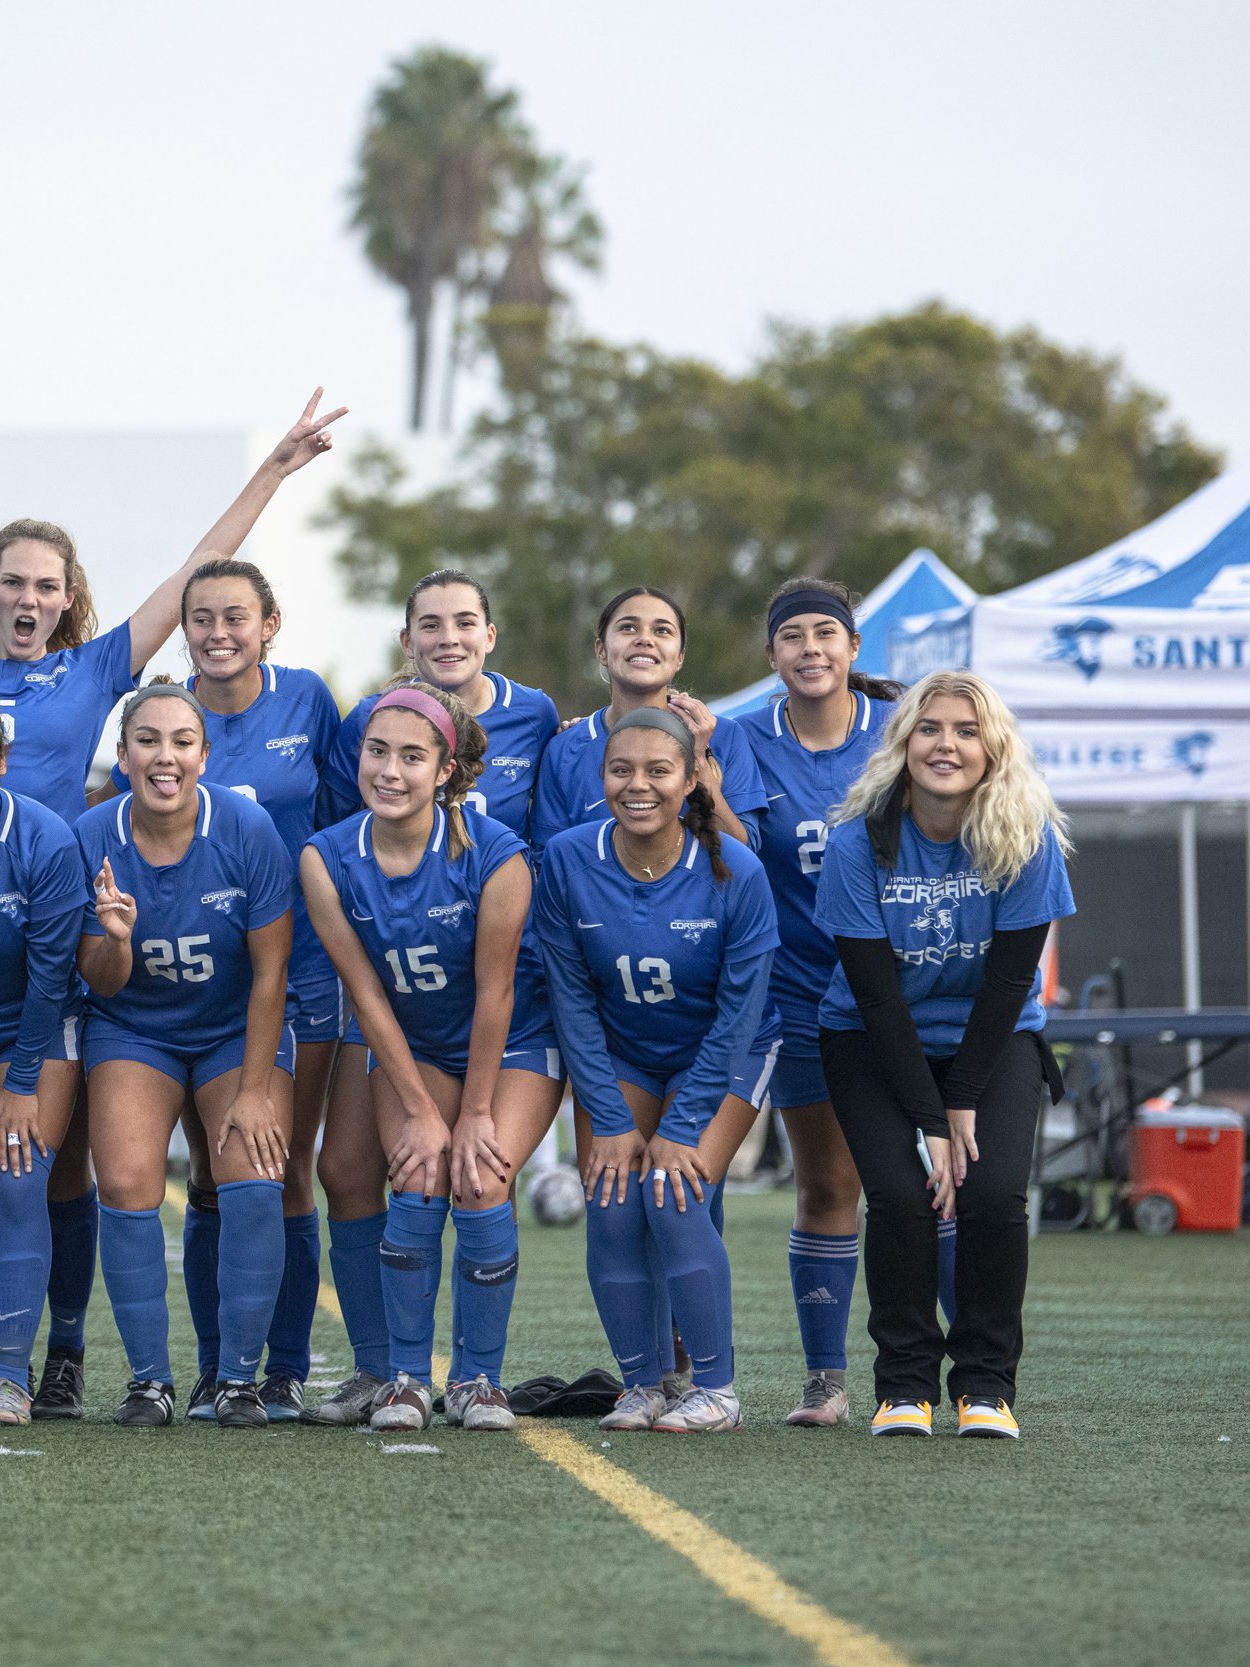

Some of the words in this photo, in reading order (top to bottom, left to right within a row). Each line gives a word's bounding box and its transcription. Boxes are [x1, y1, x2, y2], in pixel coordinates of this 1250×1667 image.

[1031, 744, 1144, 768] OLLEGE
[795, 819, 830, 874] 2
[200, 889, 247, 905] CORSAIRS
[670, 921, 718, 930] CORSAIRS
[141, 934, 215, 983] 25
[384, 944, 448, 994] 15
[615, 954, 676, 1004] 13
